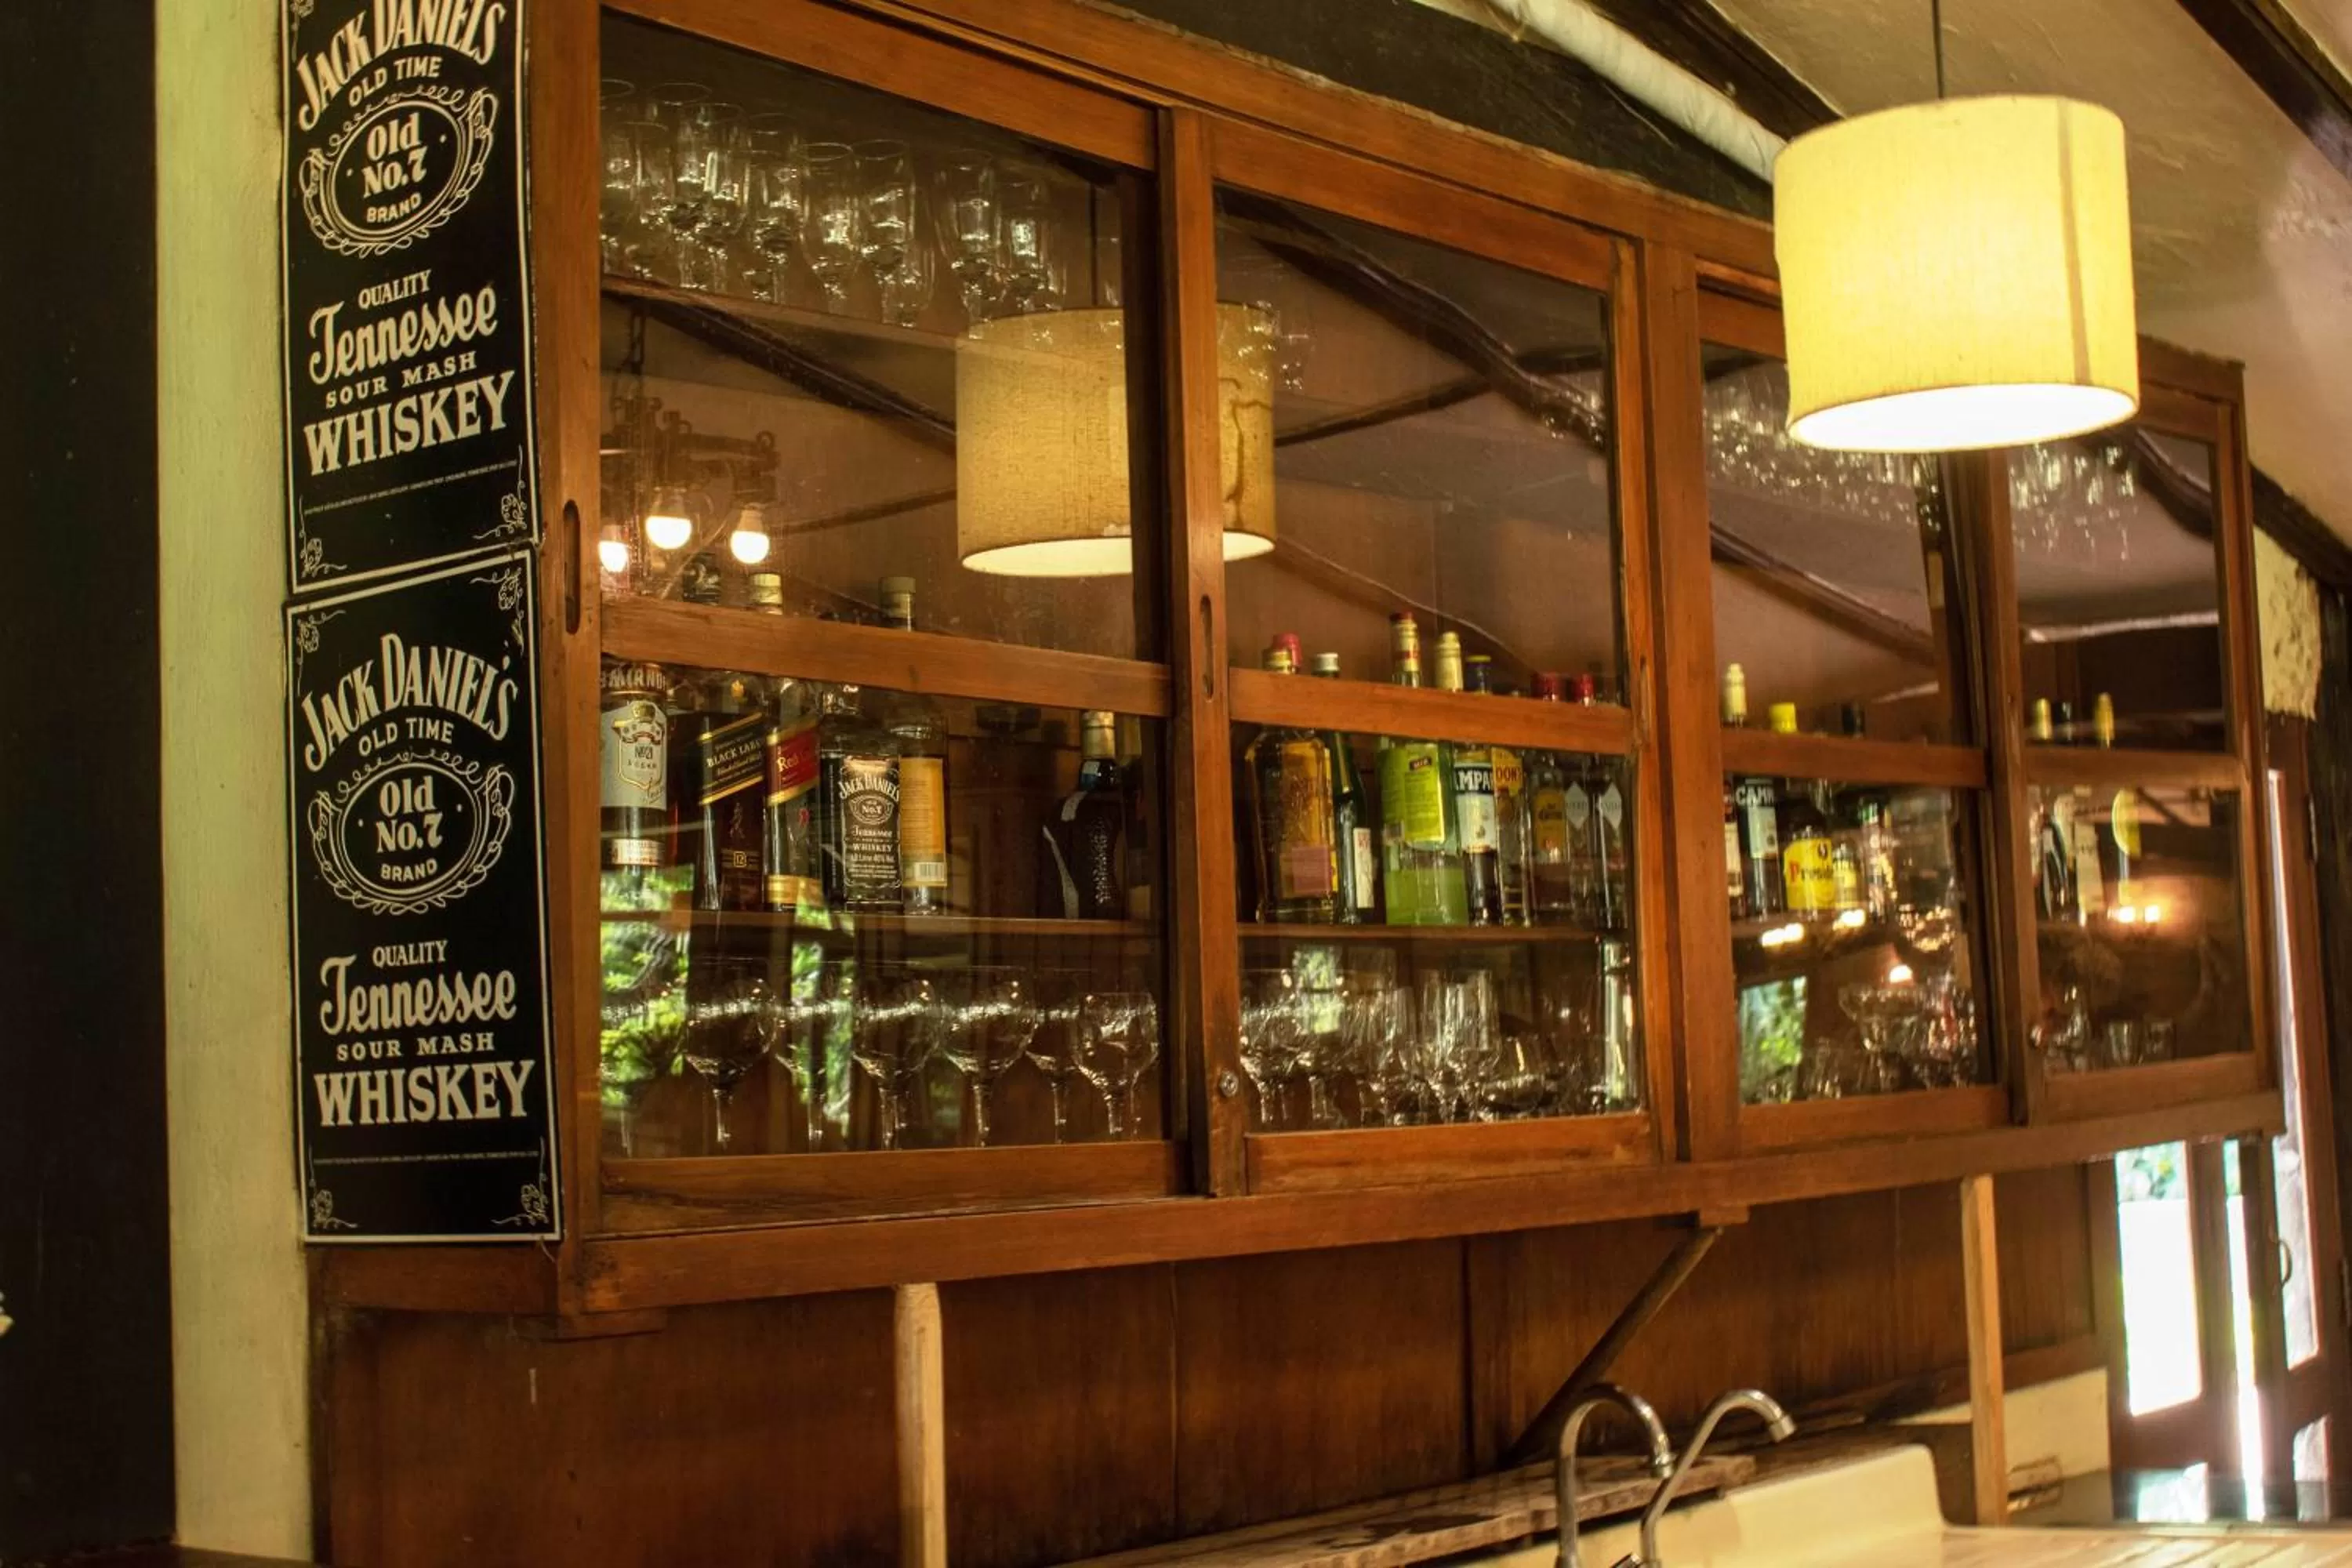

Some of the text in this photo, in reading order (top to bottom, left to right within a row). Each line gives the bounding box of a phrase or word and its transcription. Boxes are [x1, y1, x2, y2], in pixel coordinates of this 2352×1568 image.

[296, 9, 372, 132] JACK
[348, 56, 443, 107] OLD TIME
[366, 112, 422, 162] Old
[366, 192, 422, 223] BRAND
[358, 269, 431, 310] QUALITY
[309, 287, 498, 385] Tennessee
[325, 350, 477, 409] SOUR MASH
[303, 370, 515, 476] WHISKEY
[301, 633, 518, 772] JACK DANIEL'S
[358, 717, 455, 757] OLD TIME
[379, 775, 436, 818] Old
[380, 858, 437, 883] BRAND
[372, 940, 448, 969] QUALITY
[320, 954, 517, 1036] Tennessee
[336, 1032, 495, 1062] SOUR MASH
[314, 1059, 535, 1127] WHISKEY
